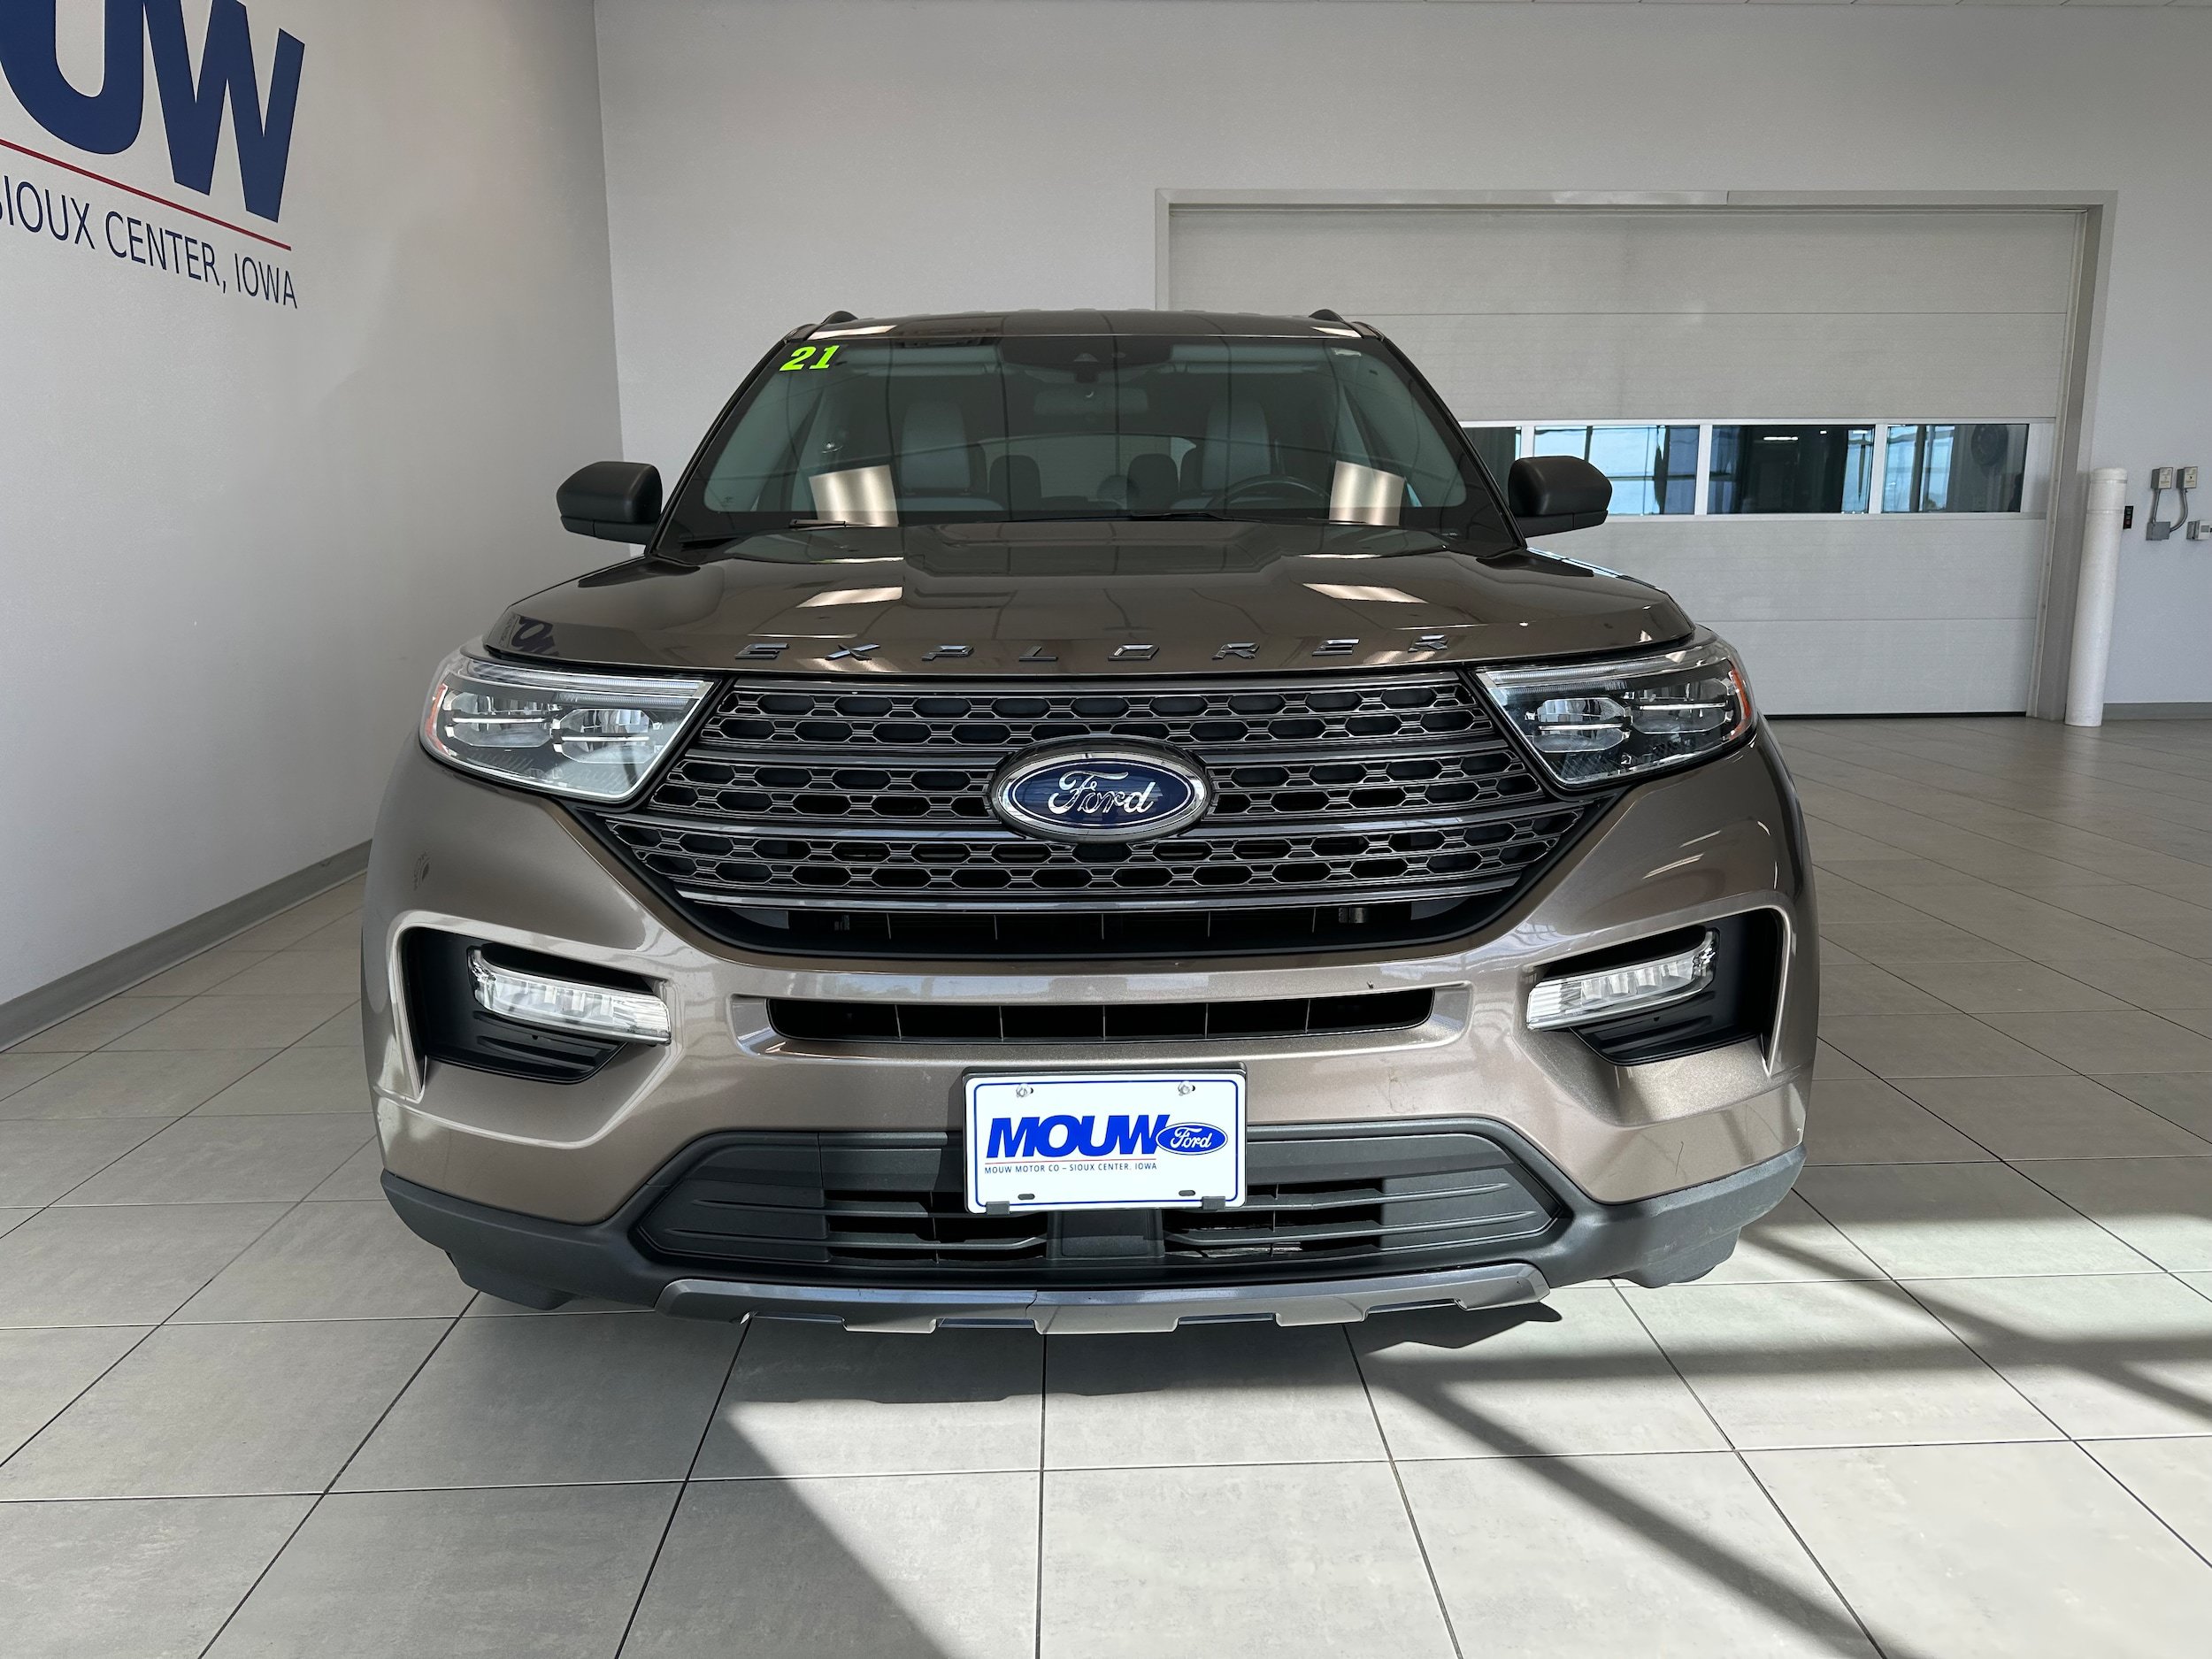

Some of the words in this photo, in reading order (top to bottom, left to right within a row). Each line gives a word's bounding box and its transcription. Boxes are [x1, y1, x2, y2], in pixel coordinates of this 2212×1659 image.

[0, 175, 96, 250] IOUX
[105, 211, 227, 294] CENTER,
[234, 253, 297, 309] IOWA
[780, 344, 840, 372] 21
[734, 634, 1449, 661] EXPLORER
[1048, 770, 1156, 814] Ford
[987, 1114, 1171, 1159] MOUW
[1170, 1127, 1212, 1149] Ford
[1015, 1164, 1046, 1173] MOTOR
[1069, 1163, 1094, 1171] SIOUX
